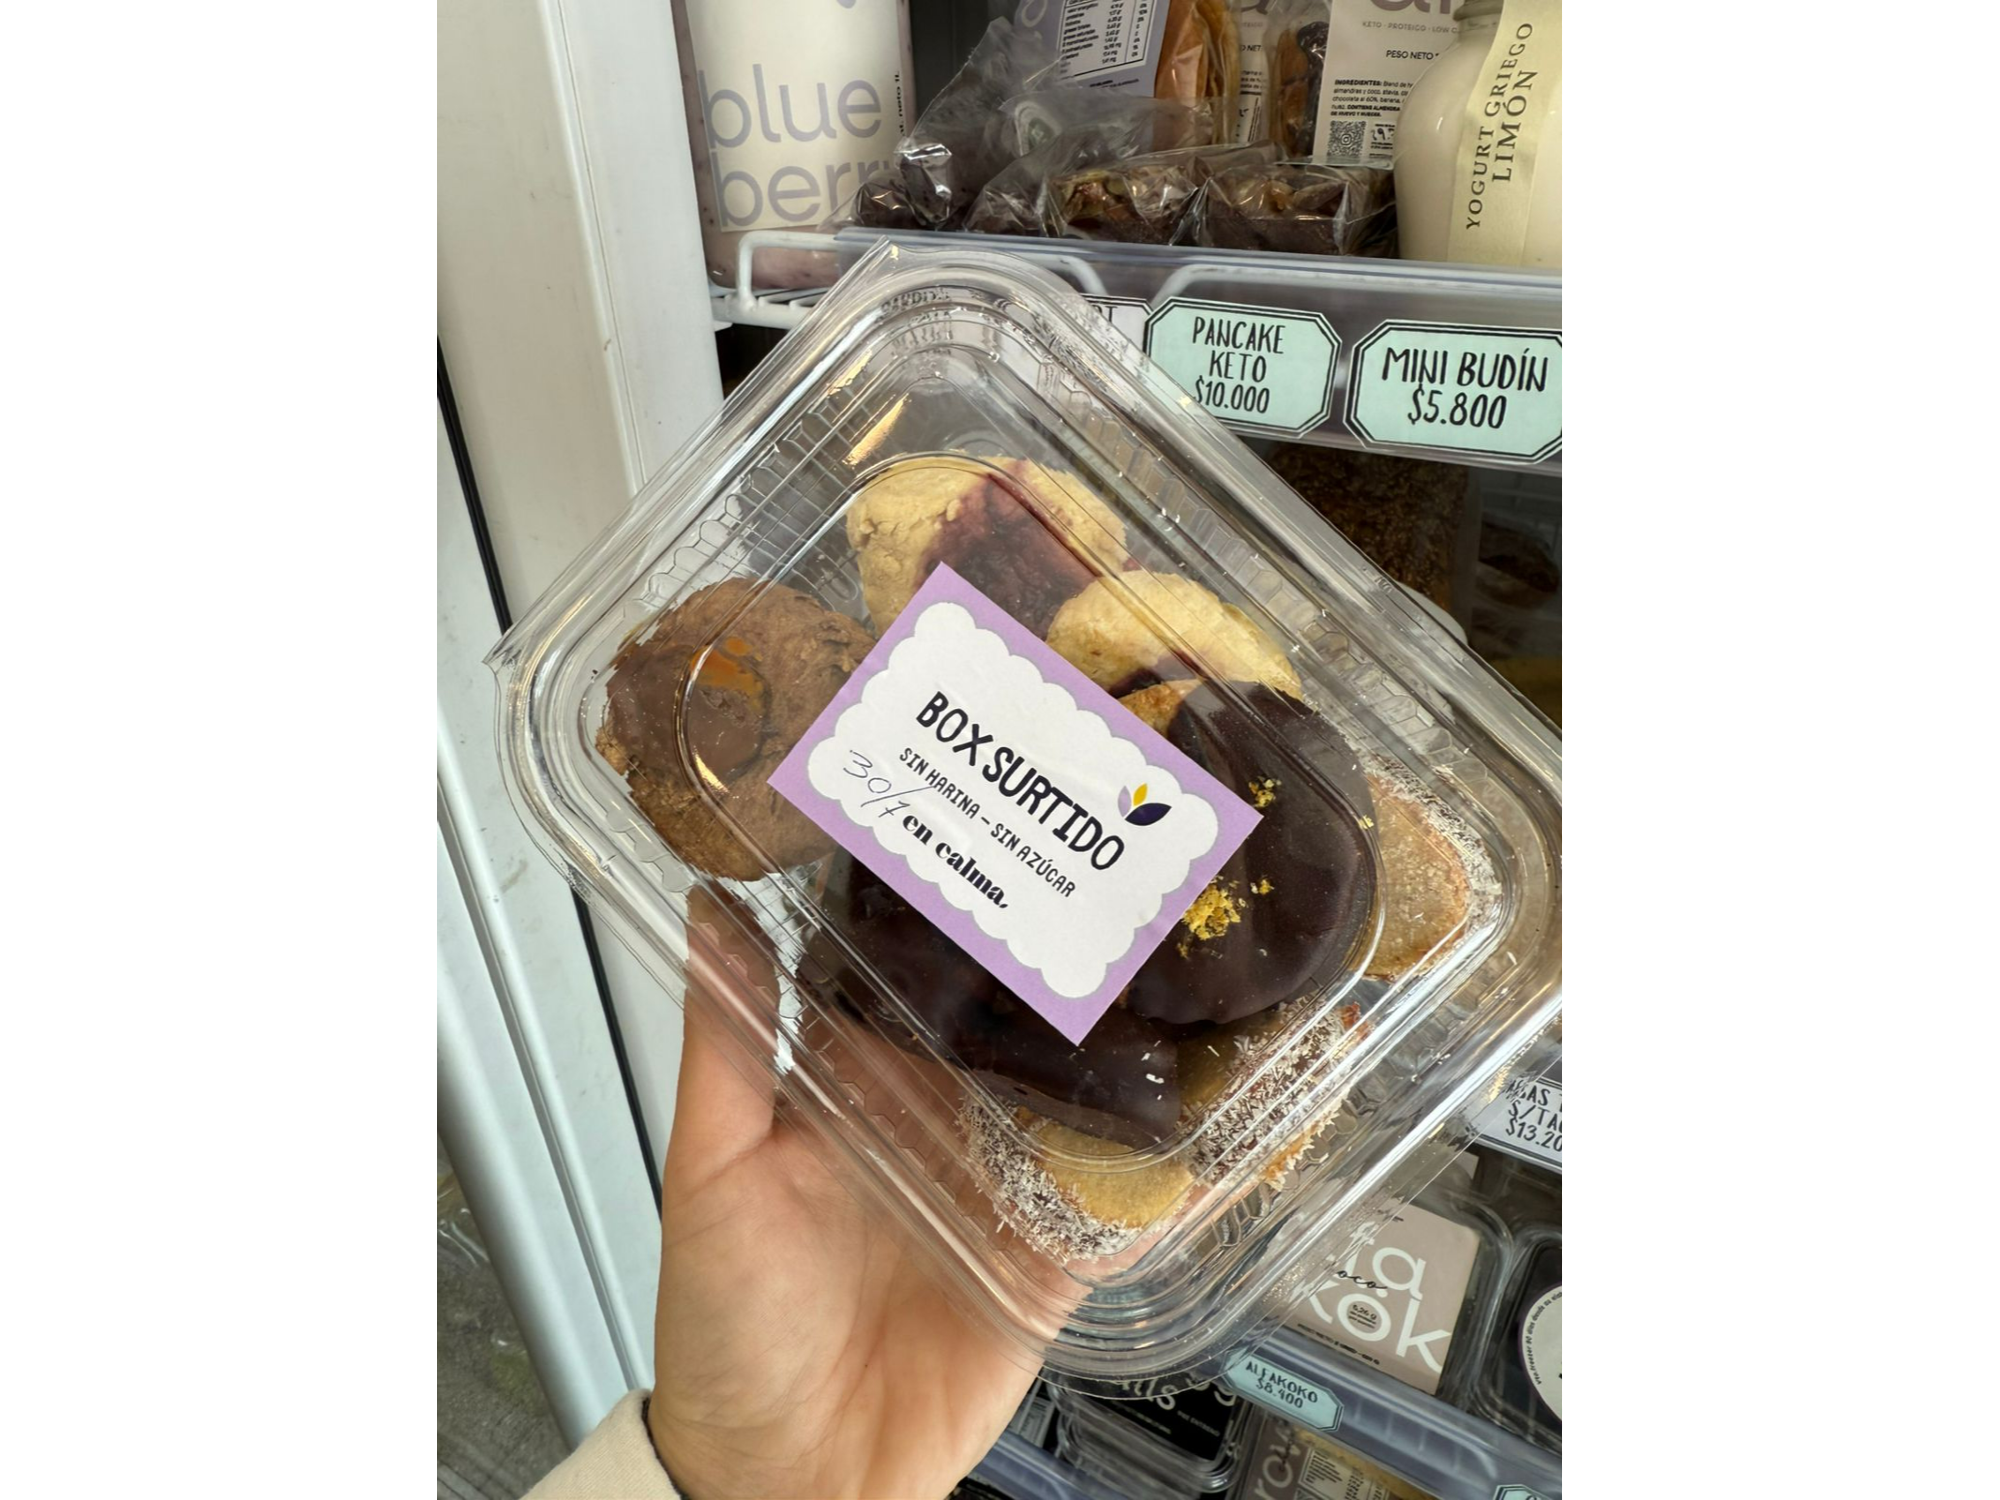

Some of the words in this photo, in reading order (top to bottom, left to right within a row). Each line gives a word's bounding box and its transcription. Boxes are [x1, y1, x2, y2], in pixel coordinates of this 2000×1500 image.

[1386, 50, 1408, 59] PESO
[1410, 51, 1434, 60] NETO
[698, 63, 882, 149] blue
[1466, 126, 1494, 230] YOGURT
[1484, 23, 1533, 117] GRIEGO
[1492, 69, 1538, 182] LIMÓN
[1192, 316, 1286, 355] PANCAKE
[1209, 350, 1267, 383] KETO
[1382, 347, 1449, 385] MINI
[1456, 348, 1549, 393] BUDÍN
[1194, 375, 1271, 414] $10.000
[1407, 383, 1507, 430] $5.800
[916, 691, 994, 767] BOX
[899, 747, 928, 776] SIN
[925, 768, 981, 819] HARINA
[990, 822, 1021, 854] SIN
[1015, 843, 1077, 898] AZÚCAR
[982, 746, 1125, 871] SURTIDO
[902, 814, 936, 846] en
[934, 840, 1009, 910] calma.
